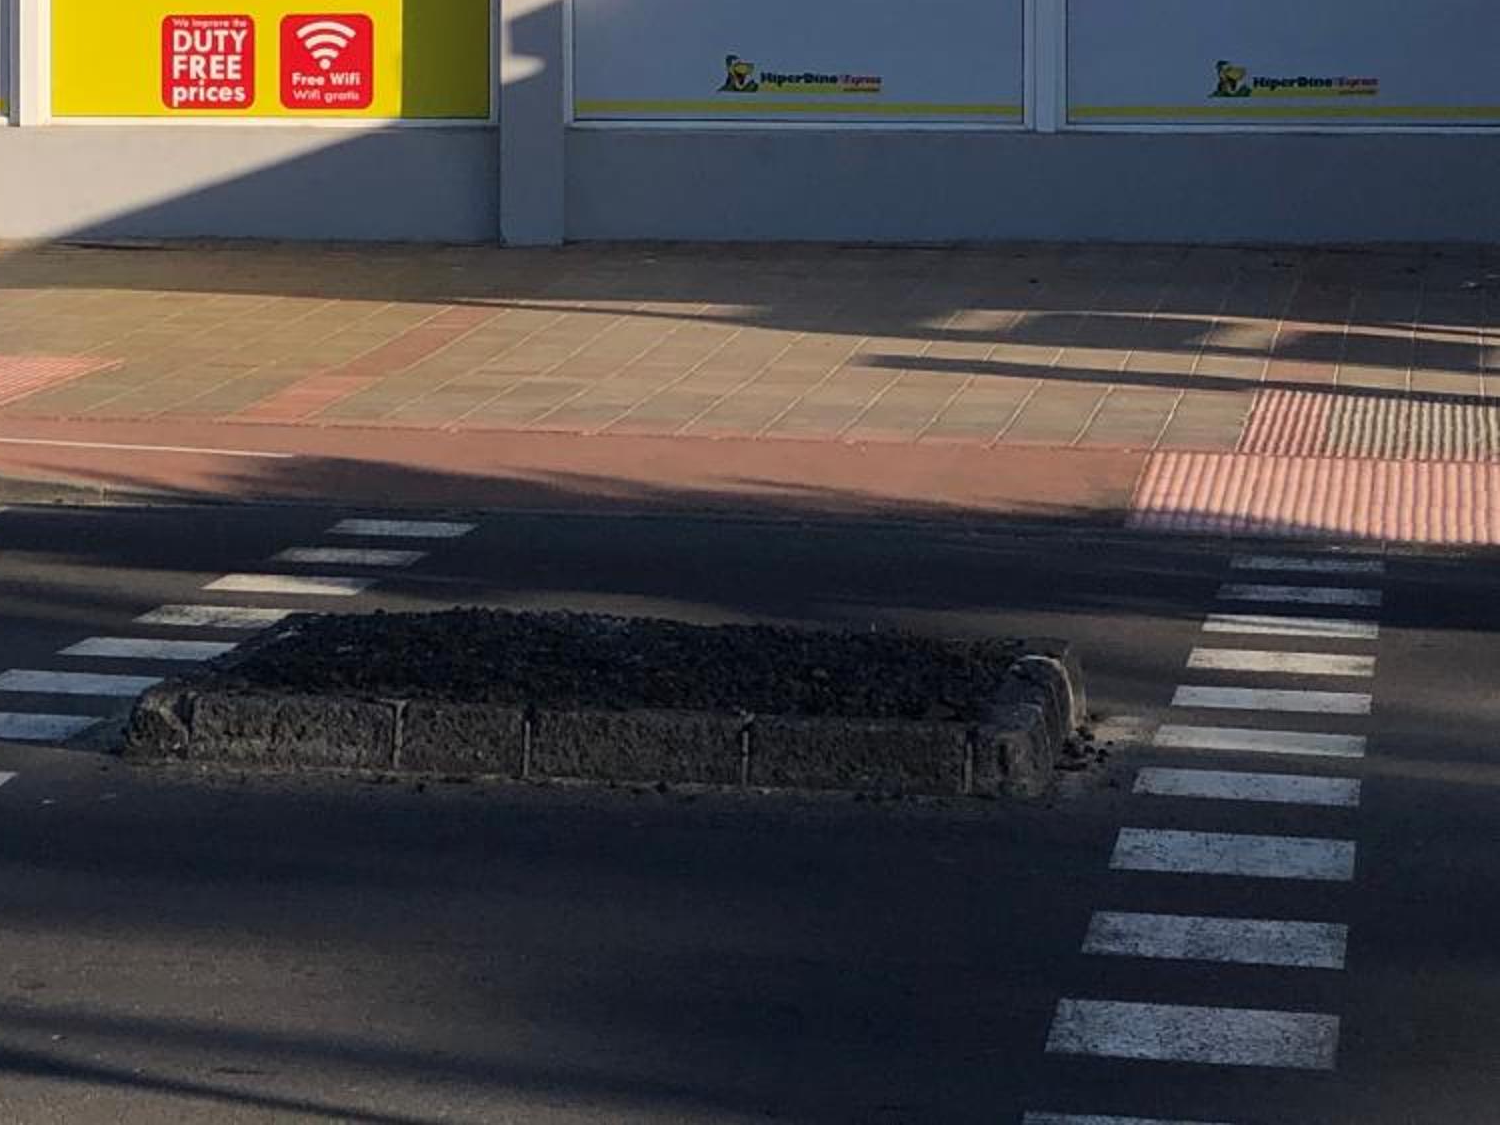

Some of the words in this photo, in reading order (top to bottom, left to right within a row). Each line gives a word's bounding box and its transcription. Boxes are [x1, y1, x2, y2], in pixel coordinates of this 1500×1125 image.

[172, 29, 248, 53] DUTY
[172, 54, 244, 80] FREE
[291, 71, 325, 86] Free
[330, 71, 361, 85] Wifi
[172, 77, 247, 107] prices
[293, 88, 322, 100] Wifi
